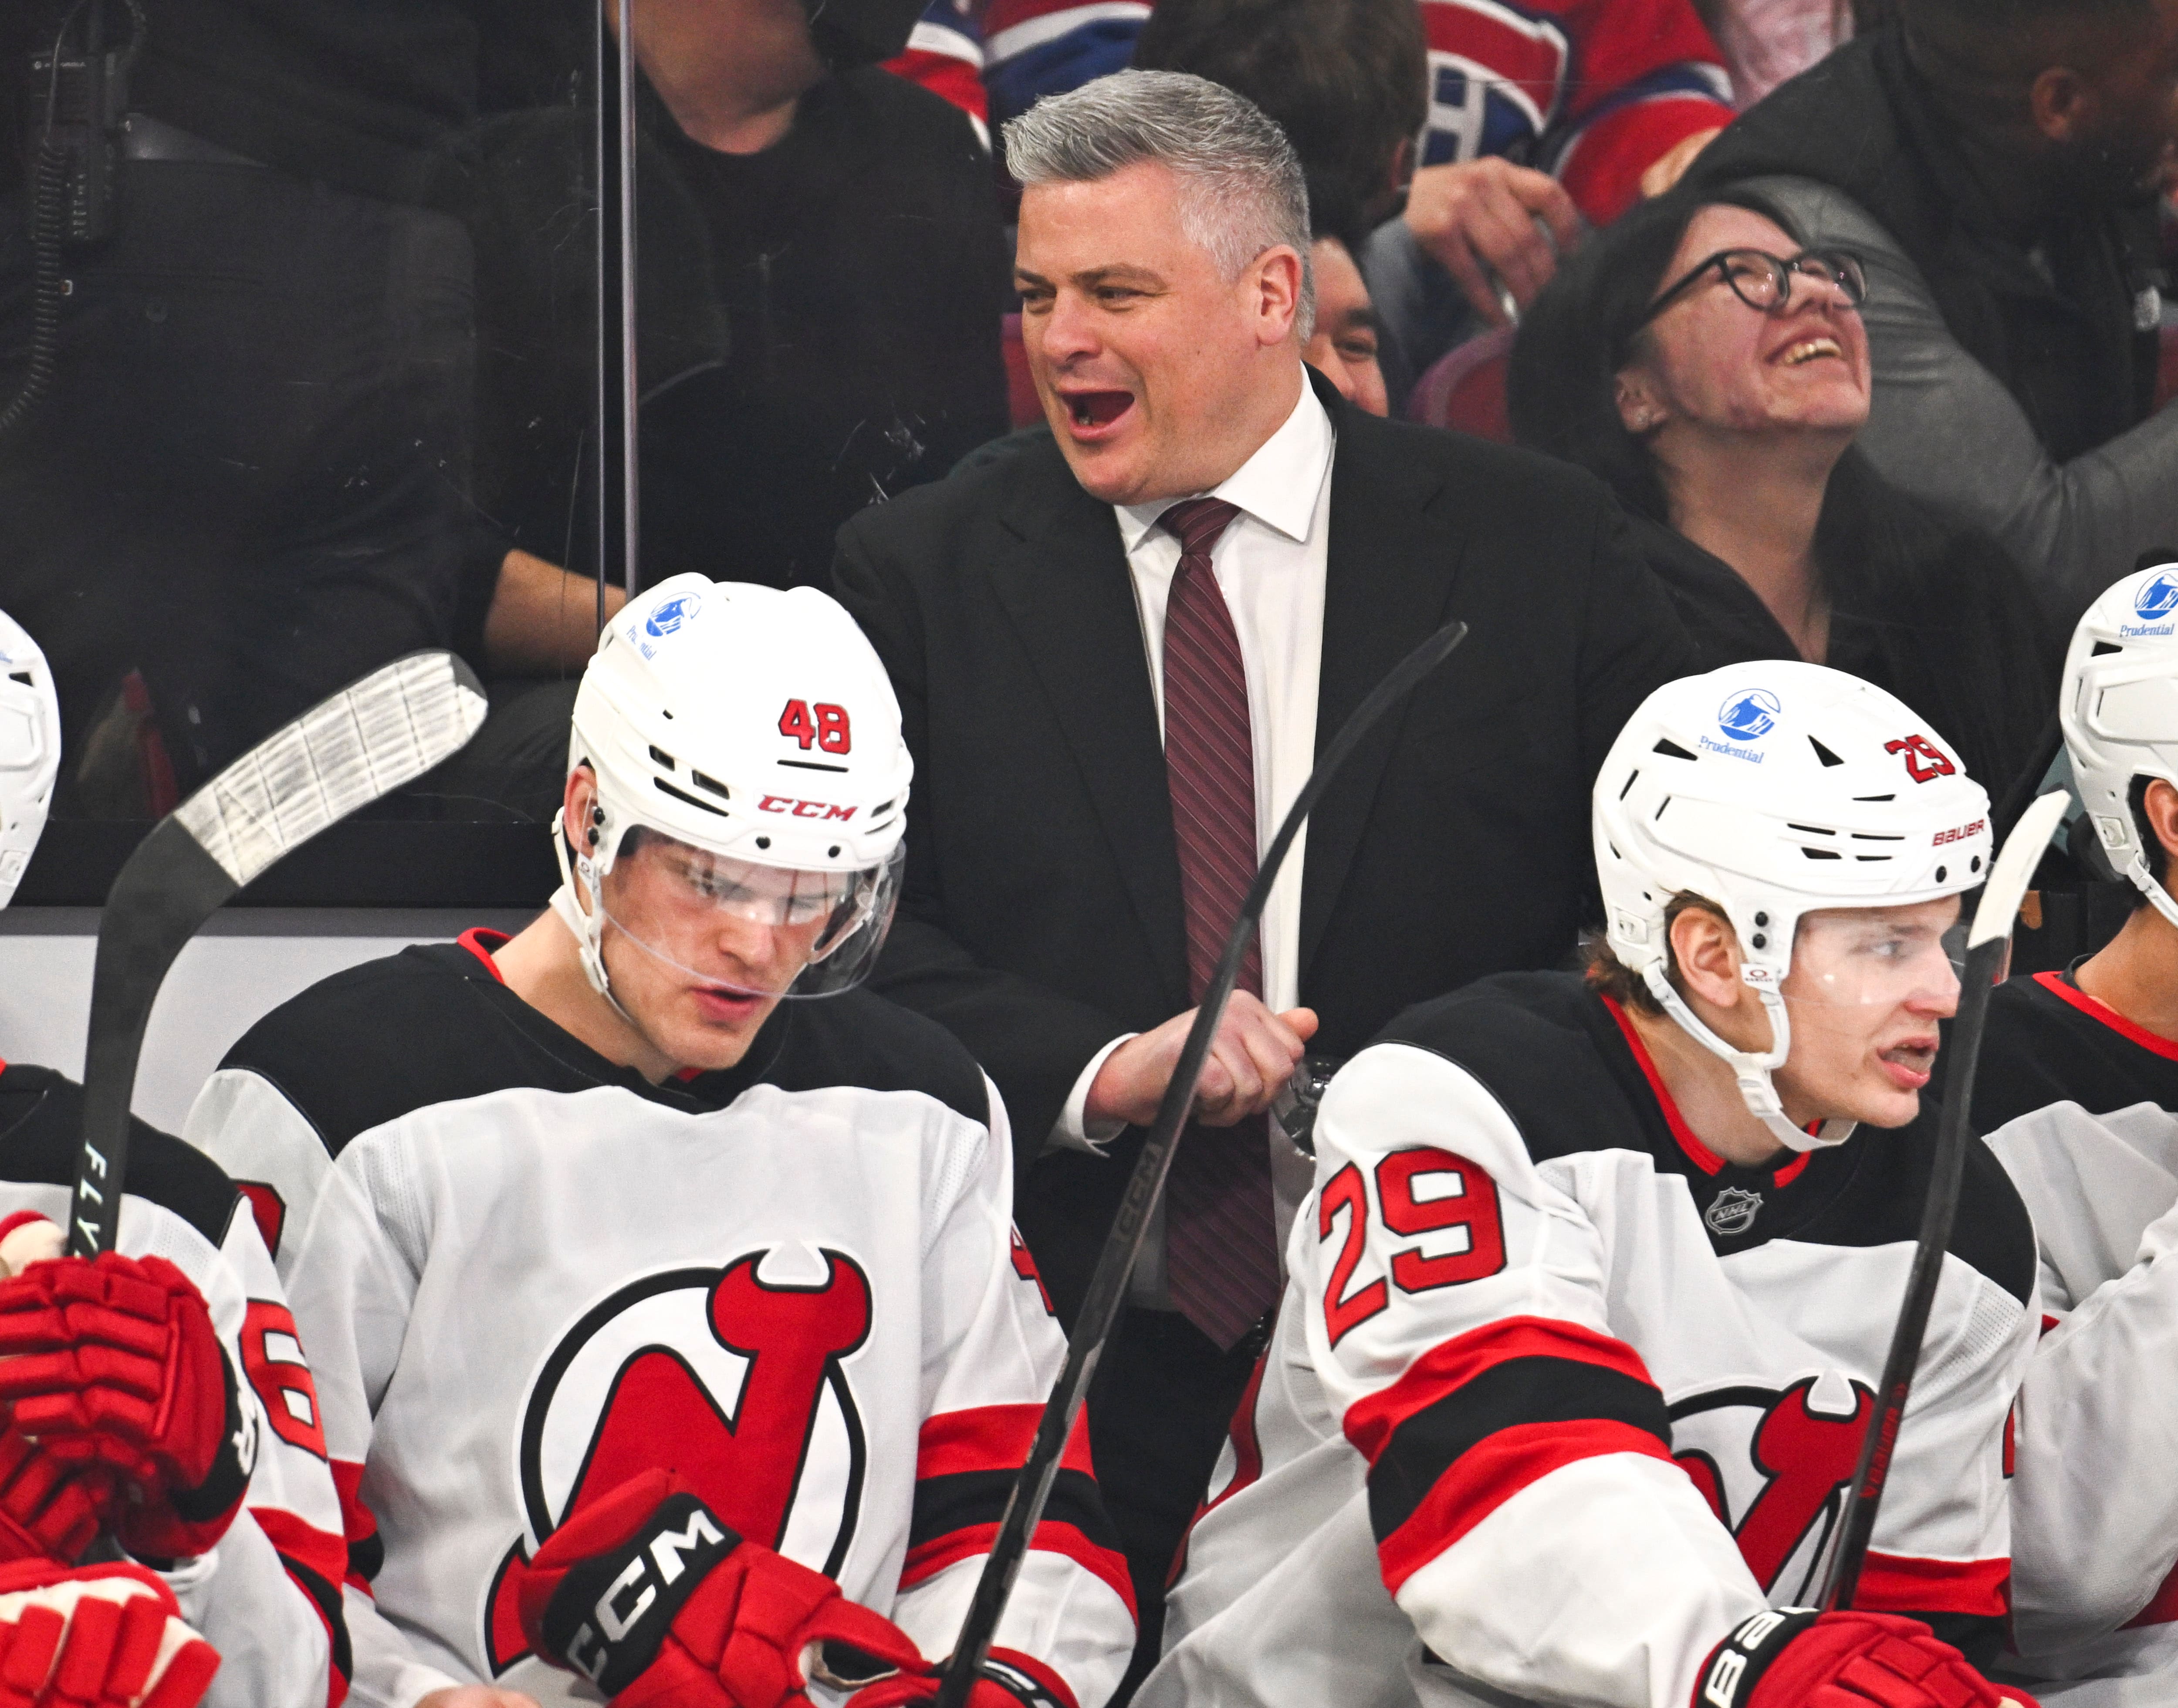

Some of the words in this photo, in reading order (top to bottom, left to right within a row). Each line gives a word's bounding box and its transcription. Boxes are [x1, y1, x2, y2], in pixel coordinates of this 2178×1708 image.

[626, 624, 657, 661] Pruntial
[2119, 623, 2175, 637] Prudential
[778, 698, 851, 755] 48
[1698, 735, 1765, 764] Prudential
[1884, 734, 1956, 784] 29
[758, 794, 858, 821] CCM
[1932, 819, 1984, 847] BAUER
[1715, 1202, 1751, 1221] NHL
[1319, 1146, 1508, 1352] 29
[567, 1509, 726, 1684] CCM
[1704, 1605, 1821, 1708] BA
